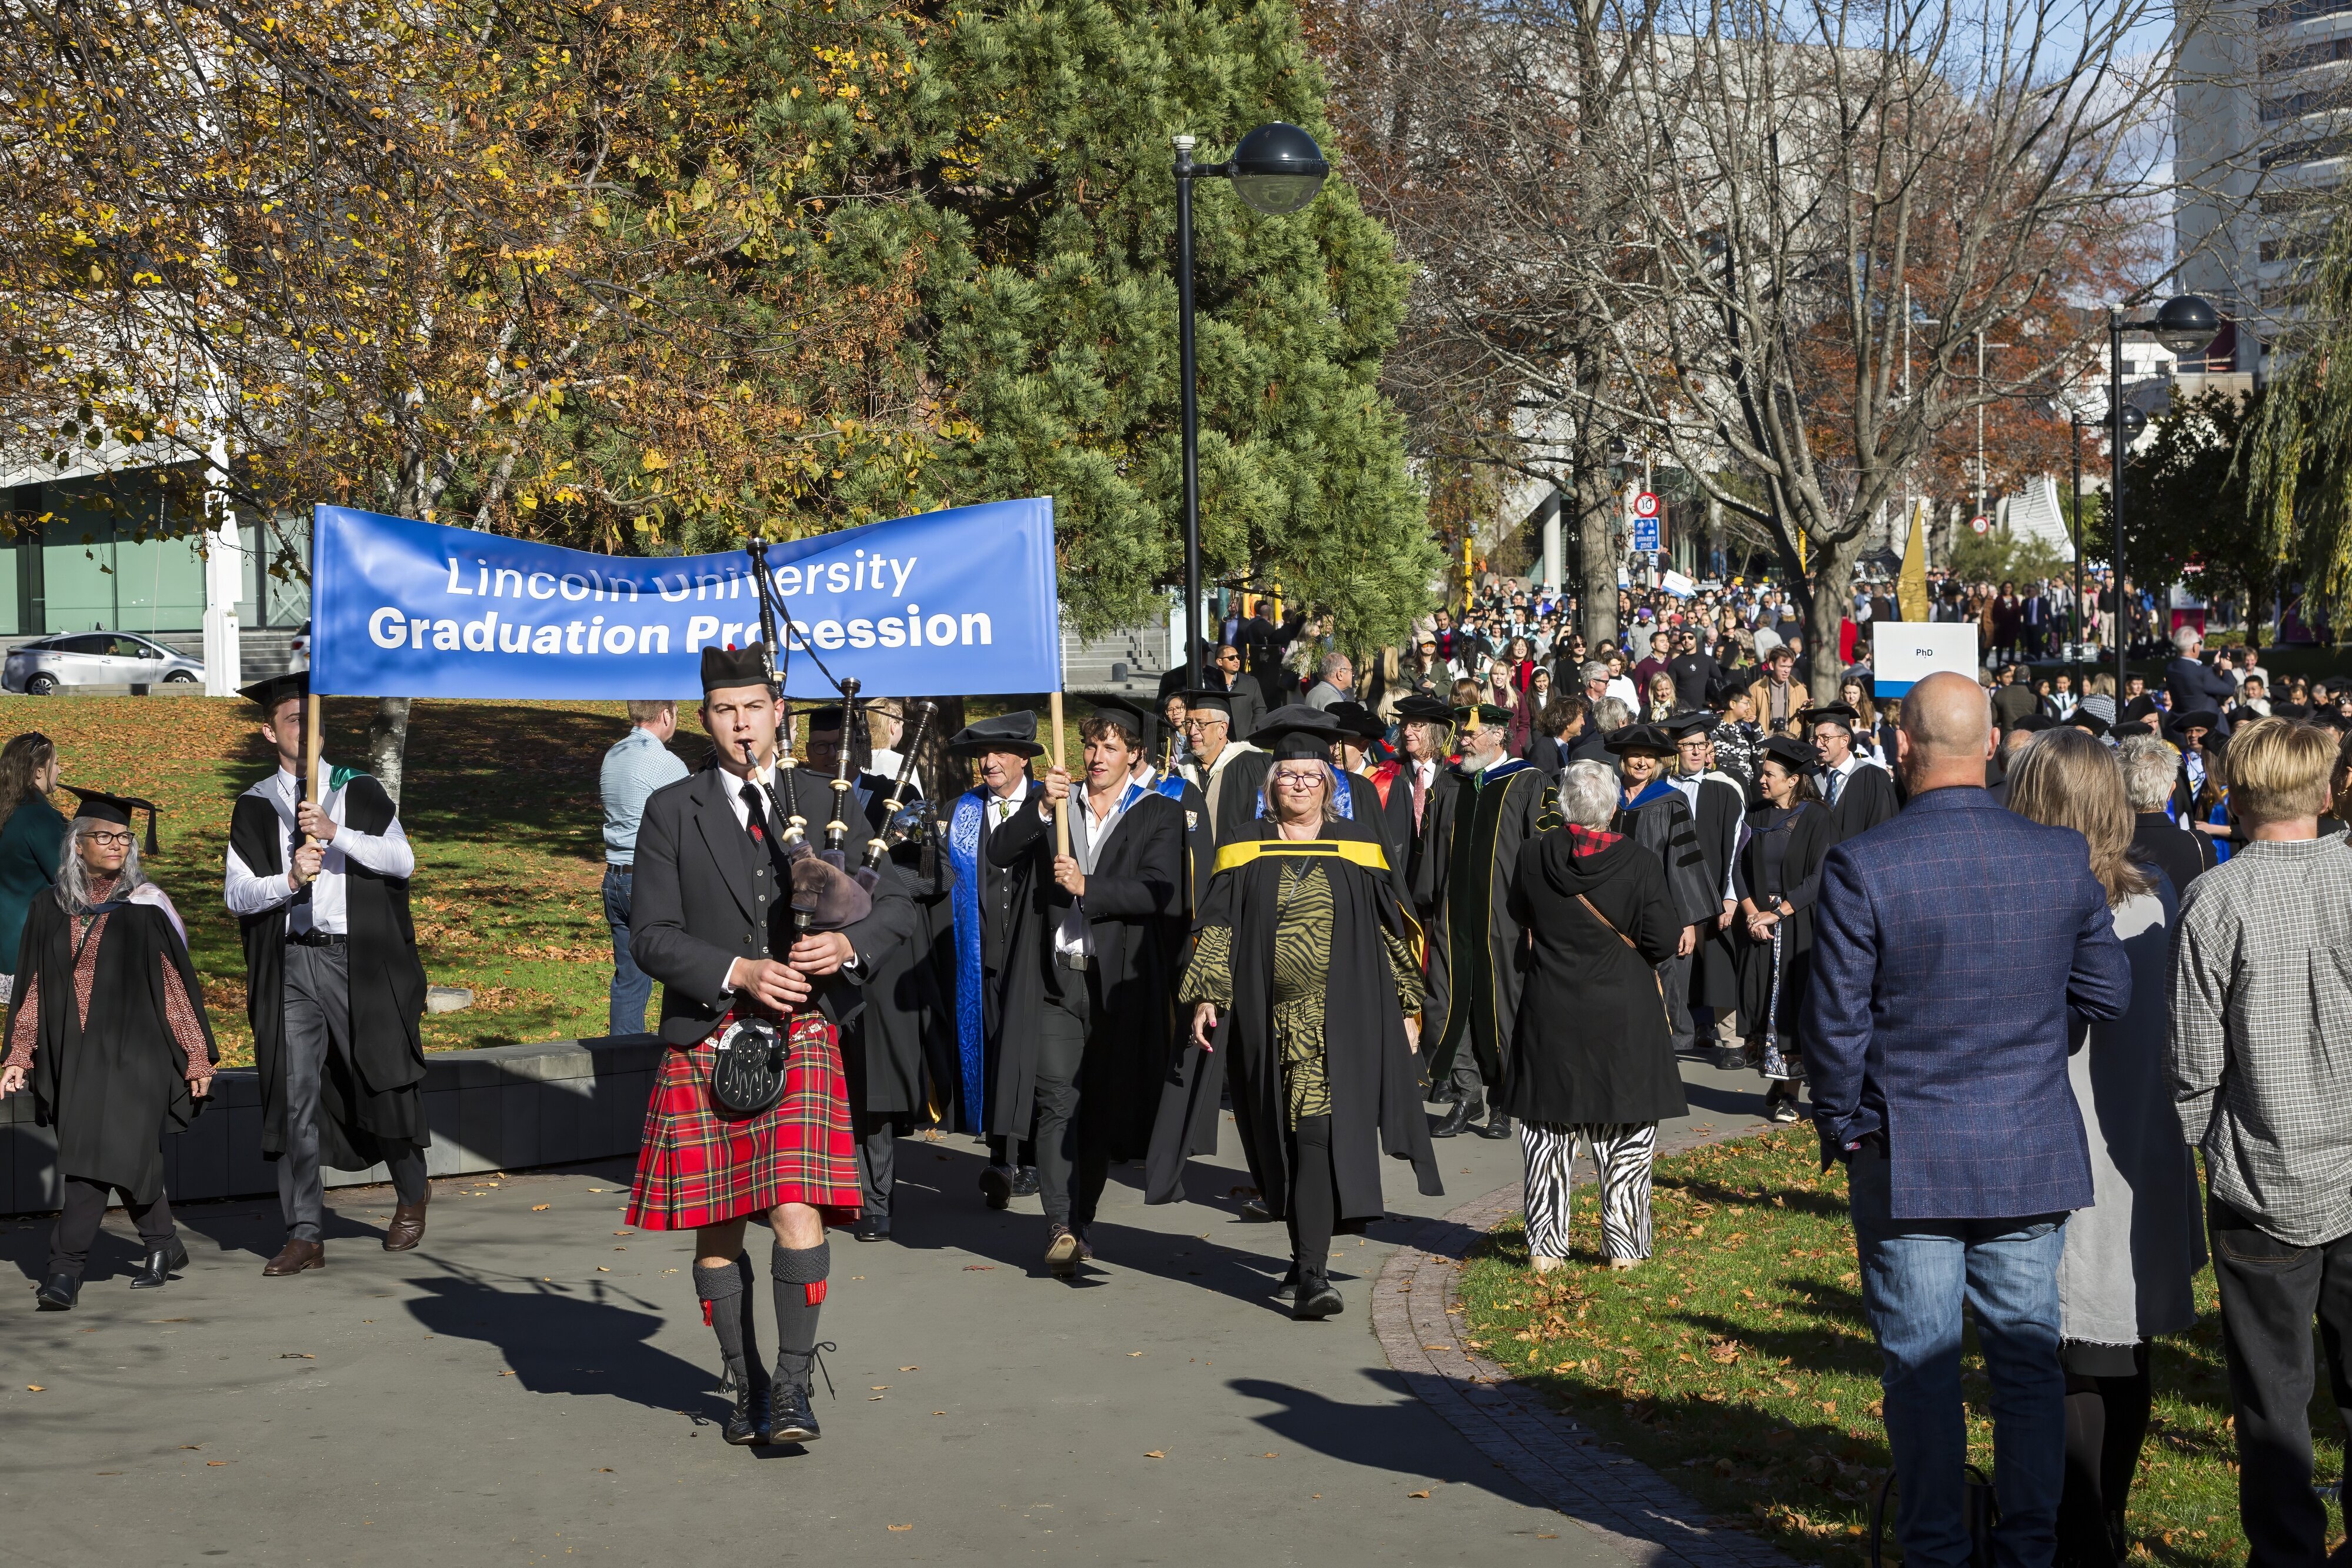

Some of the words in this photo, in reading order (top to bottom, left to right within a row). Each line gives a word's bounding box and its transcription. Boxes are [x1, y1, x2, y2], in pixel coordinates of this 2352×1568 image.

[1639, 497, 1652, 509] 10
[446, 558, 639, 602] Lincoln
[652, 549, 918, 602] University
[369, 606, 670, 655] Graduation
